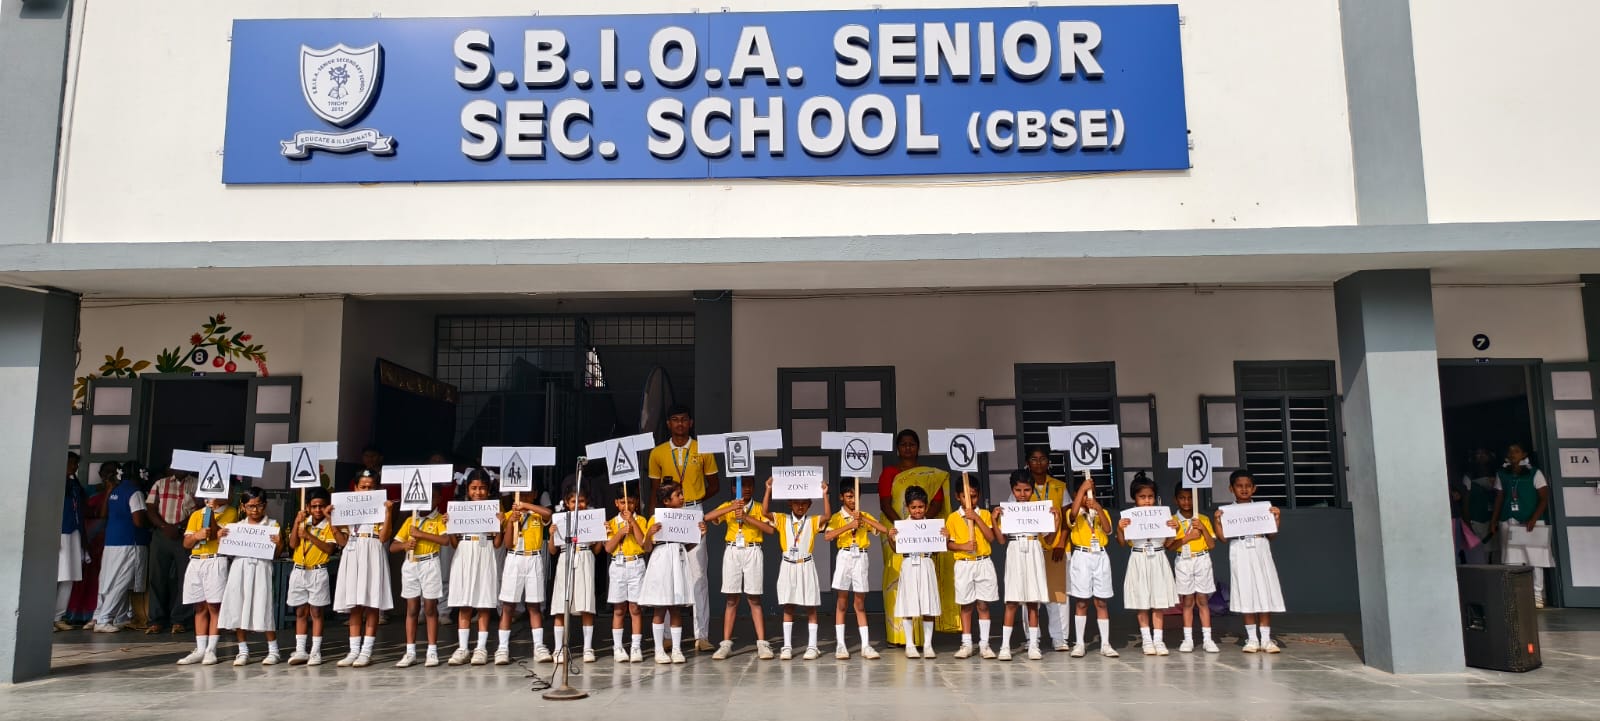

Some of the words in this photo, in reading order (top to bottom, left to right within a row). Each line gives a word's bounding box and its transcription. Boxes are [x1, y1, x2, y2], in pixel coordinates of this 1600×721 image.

[453, 25, 804, 88] S.B.I.O.A.
[833, 20, 1105, 84] SENIOR
[460, 98, 618, 160] SEC.
[646, 93, 940, 158] SCHOOL
[967, 109, 1126, 153] (CBSE)
[300, 135, 330, 144] EDUCATE
[336, 131, 372, 144] ILLUMINATE
[1476, 338, 1486, 348] 7
[195, 351, 204, 363] 8
[779, 469, 816, 478] HOSPITAL
[787, 483, 809, 491] ZONE
[346, 494, 373, 503] SPEED
[340, 507, 379, 517] BREAKER
[448, 503, 499, 512] PEDESTRIAN
[1021, 504, 1046, 512] RIGHT
[1131, 509, 1143, 518] NO
[1143, 509, 1163, 517] LEFT
[453, 517, 495, 526] CROSSING
[1016, 518, 1040, 526] TURN
[1239, 515, 1270, 524] PARKING
[668, 526, 689, 535] ROAD
[914, 523, 927, 531] NO
[1138, 522, 1161, 531] TURN
[236, 527, 267, 537] UNDER
[222, 538, 275, 551] CONSTRUCTION
[897, 536, 945, 545] OVERTAKING
